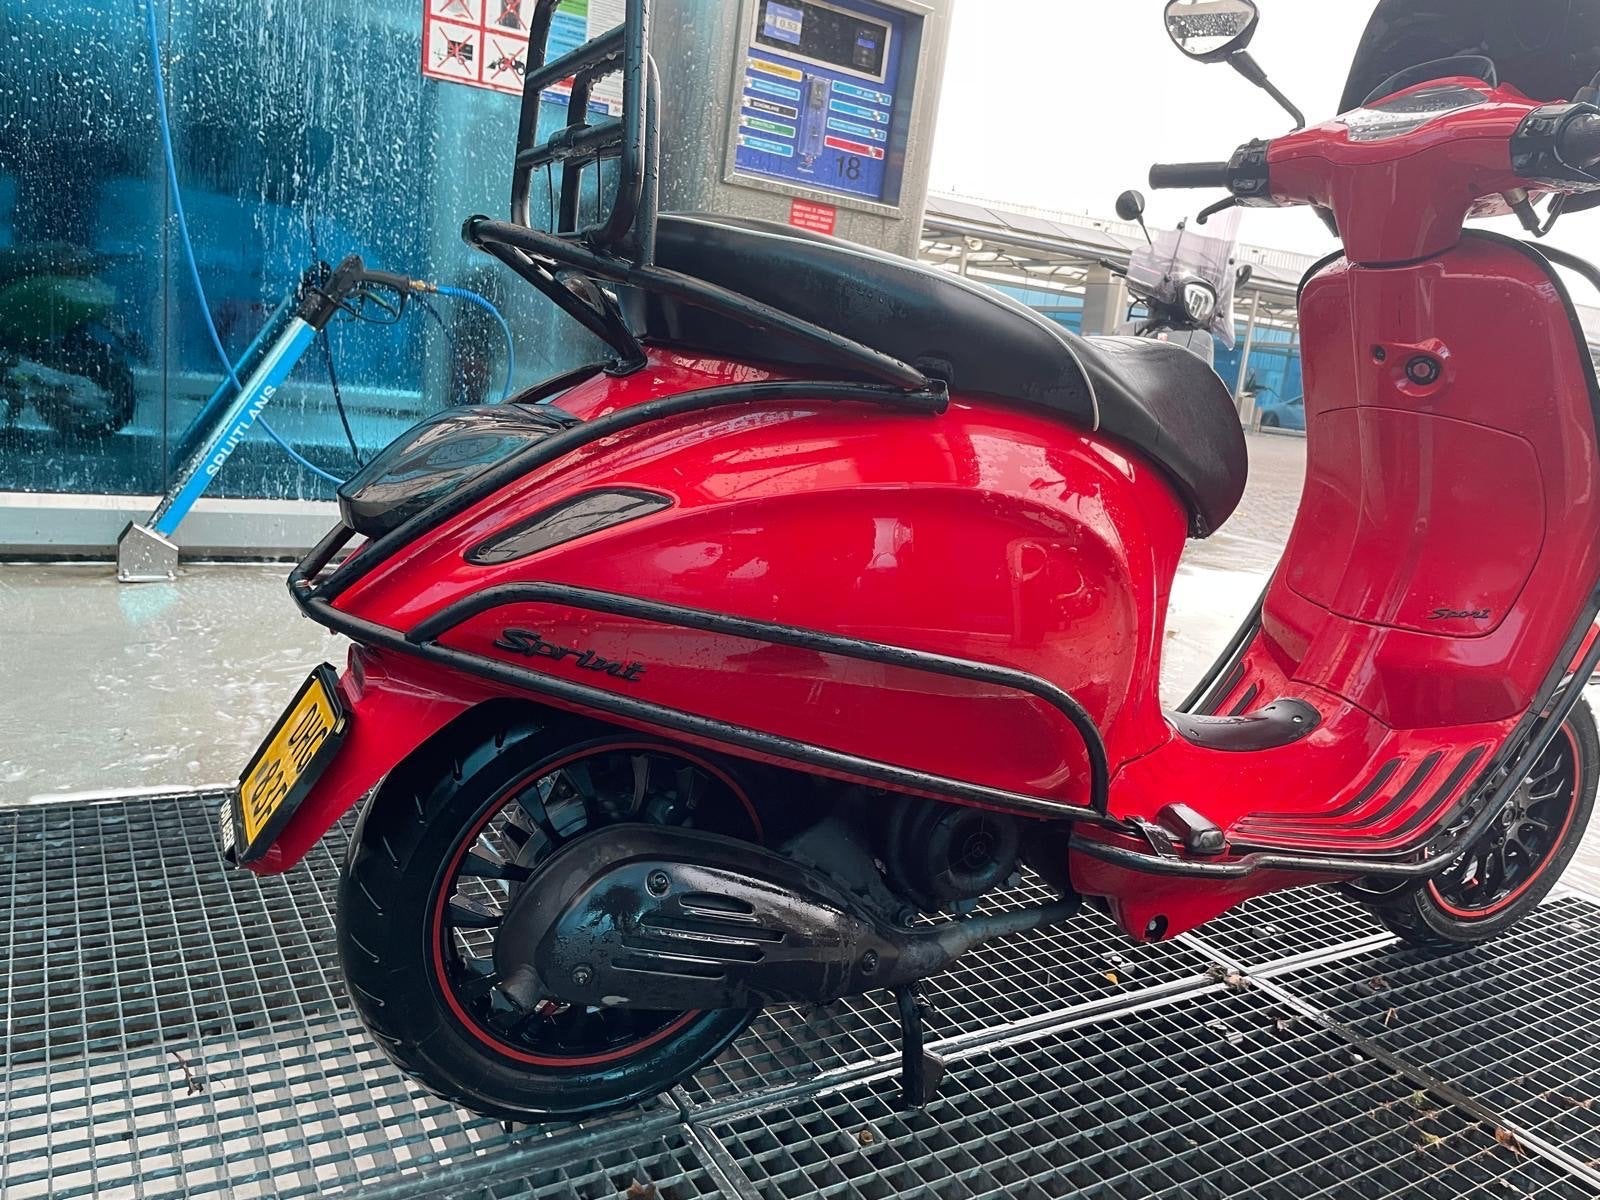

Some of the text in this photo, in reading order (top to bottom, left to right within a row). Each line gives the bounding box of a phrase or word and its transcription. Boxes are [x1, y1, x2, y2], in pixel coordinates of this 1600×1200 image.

[836, 156, 861, 180] 18
[206, 385, 277, 477] SPUITLANS
[1426, 608, 1491, 620] Sport
[492, 628, 647, 681] Sprint
[288, 702, 328, 775] DHG
[251, 759, 288, 827] 83F
